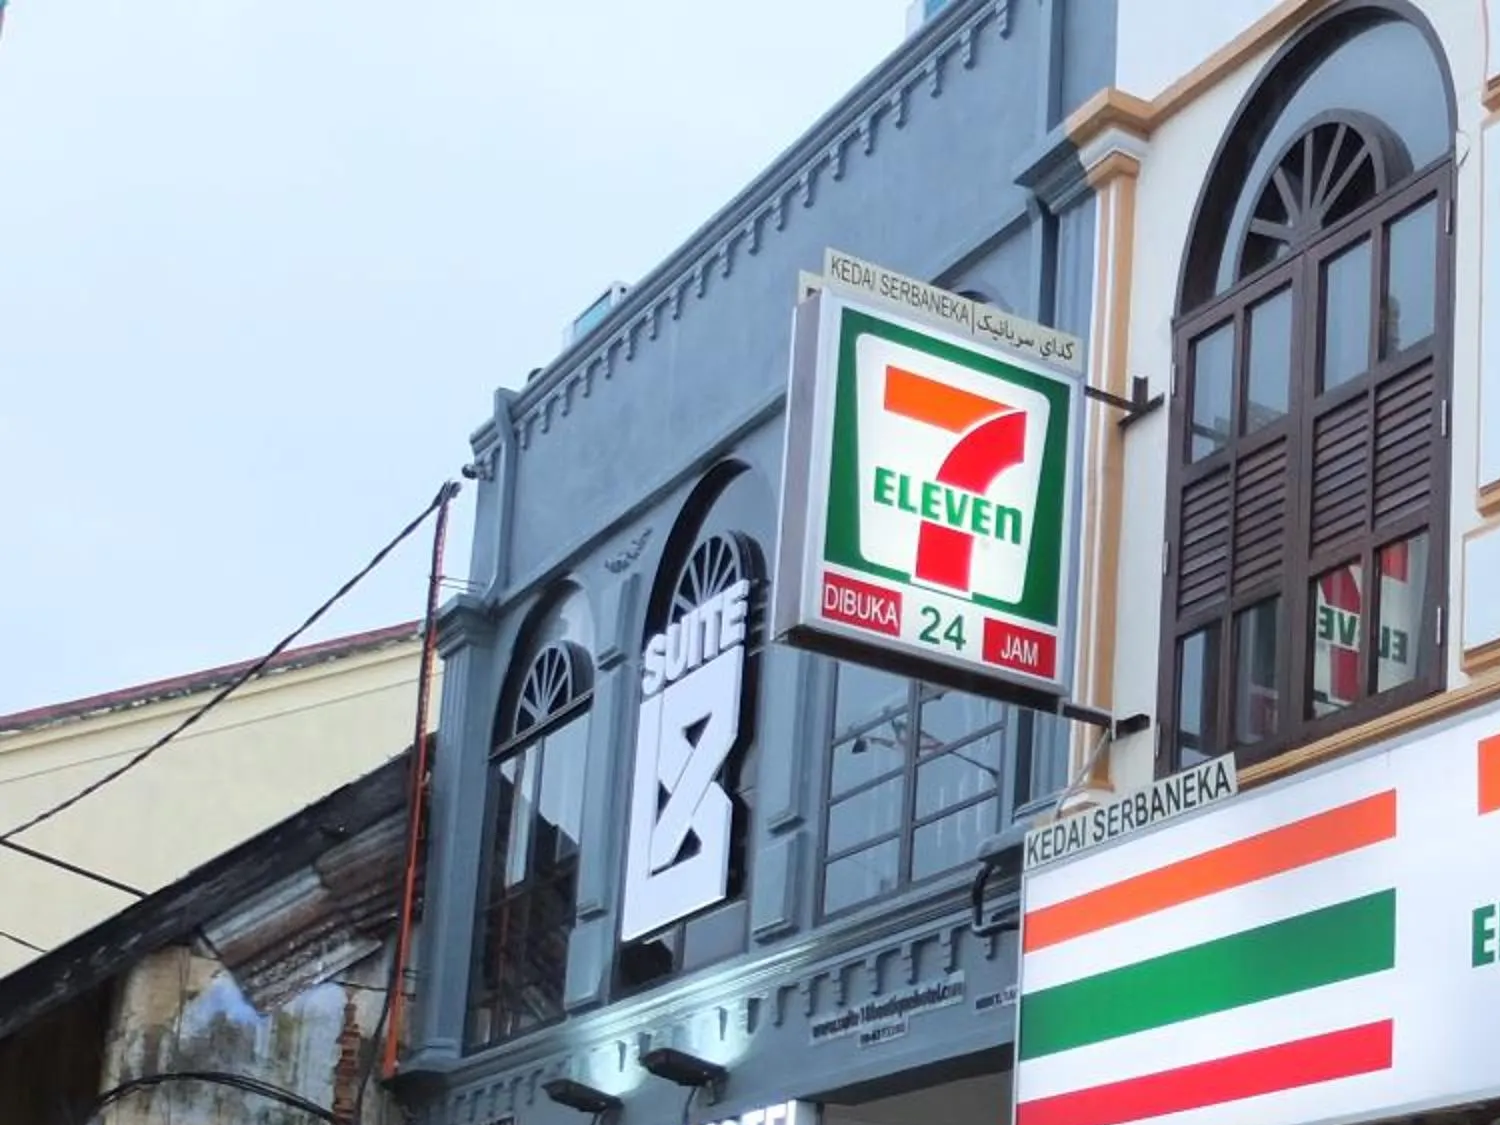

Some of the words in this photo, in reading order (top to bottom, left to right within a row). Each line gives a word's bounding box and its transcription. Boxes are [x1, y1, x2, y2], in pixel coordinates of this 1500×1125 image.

[831, 256, 876, 290] KEDAI
[880, 274, 970, 323] SERBANEKA
[884, 364, 1028, 592] 7
[641, 579, 749, 697] SUITE
[824, 582, 899, 627] DIBUKA
[918, 605, 967, 651] 24
[999, 632, 1039, 667] JAM
[1026, 817, 1088, 865] KEDAI
[1091, 760, 1232, 844] SERBANEKA
